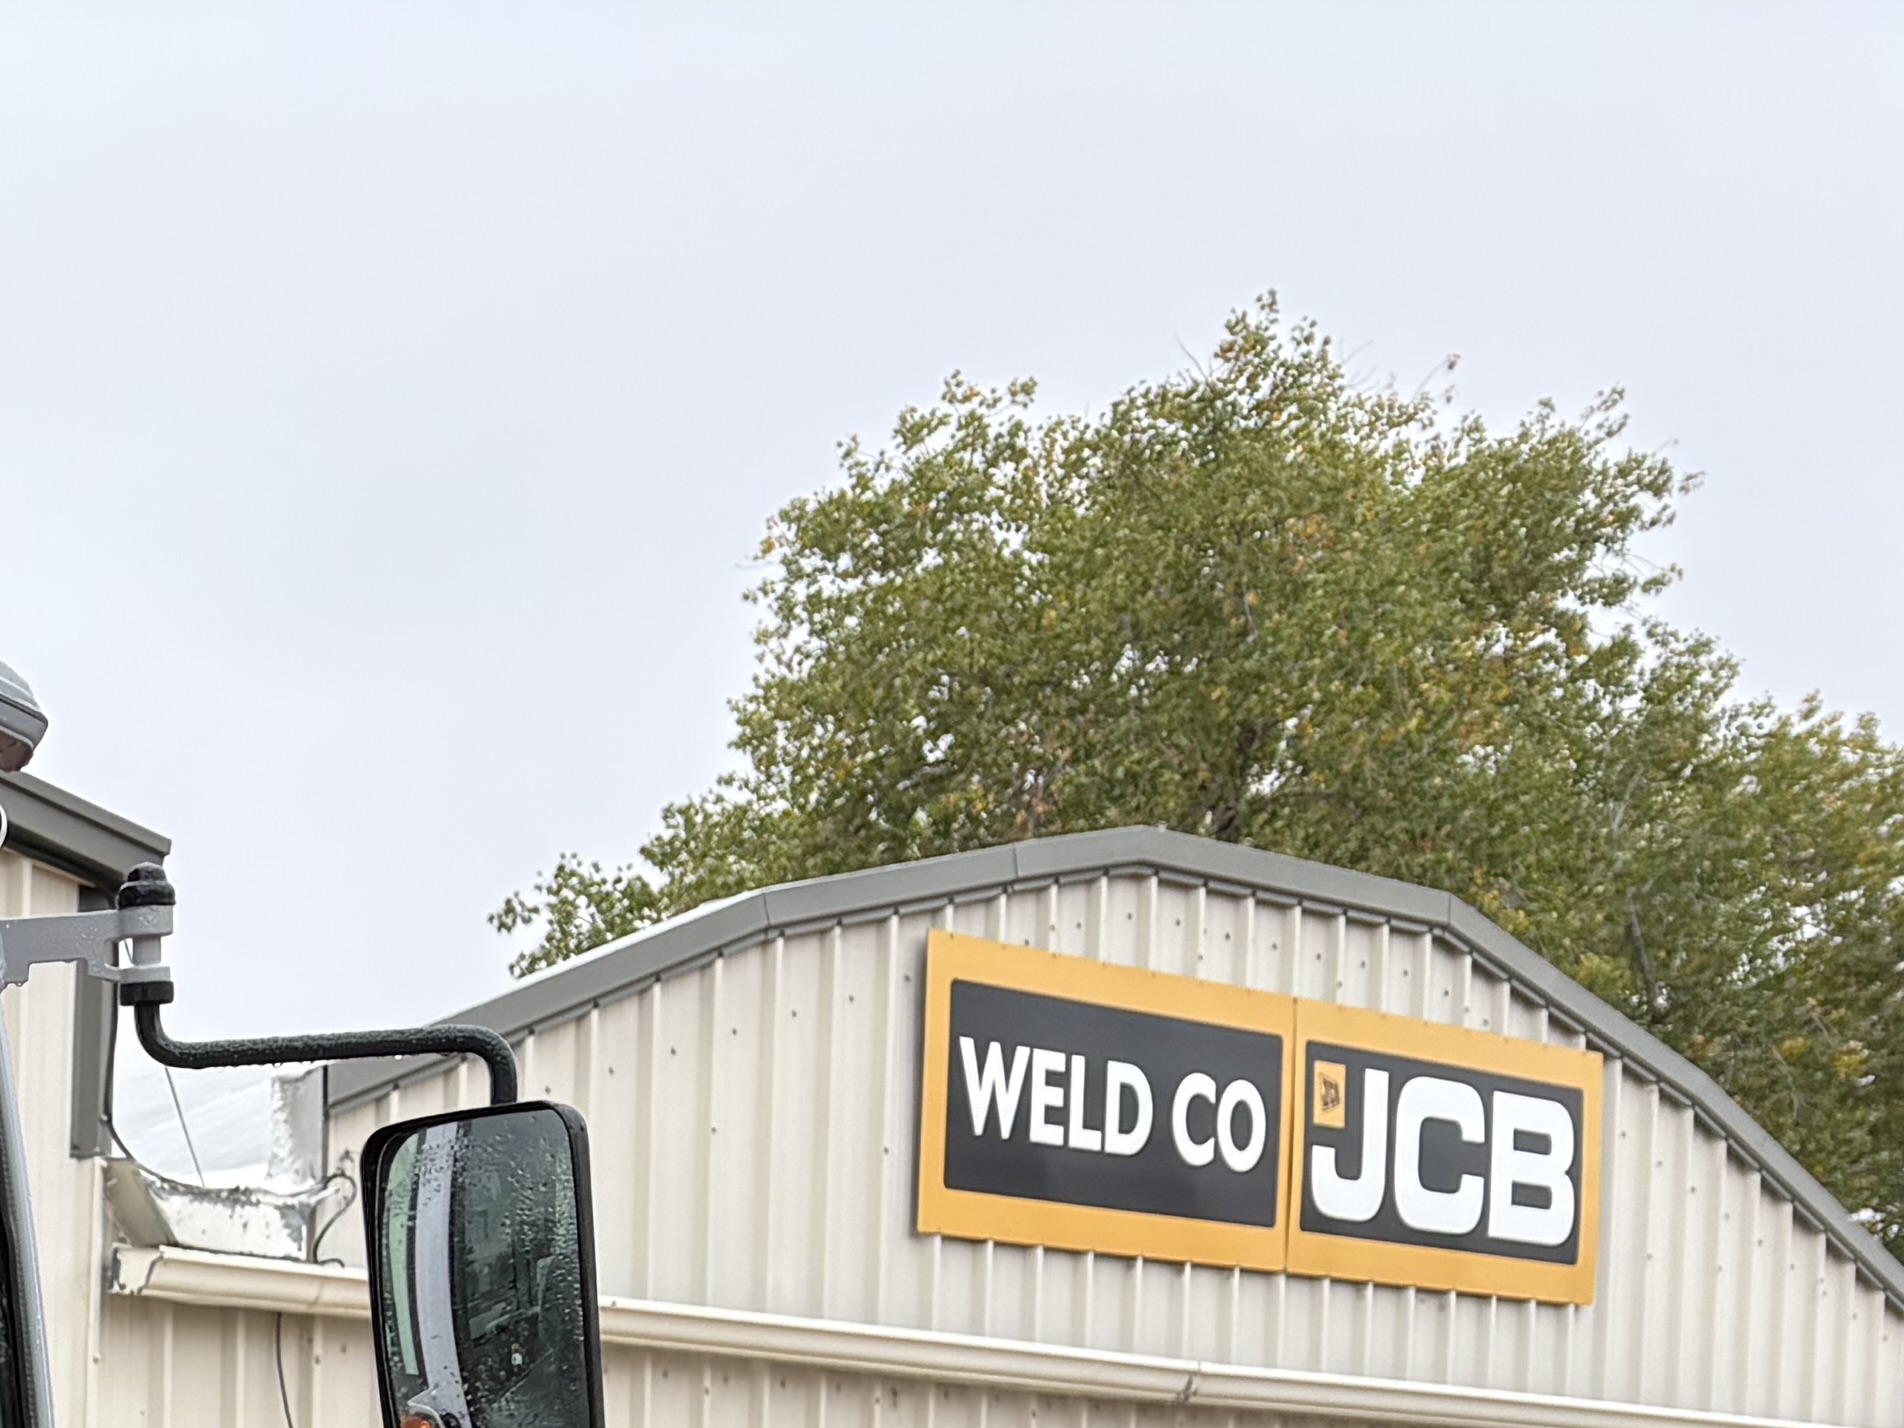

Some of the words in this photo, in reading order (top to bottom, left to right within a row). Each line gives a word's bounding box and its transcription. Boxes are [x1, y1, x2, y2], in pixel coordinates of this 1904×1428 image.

[959, 1036, 1153, 1156] WELD
[1172, 1072, 1267, 1173] CO
[1311, 1067, 1576, 1247] JCB
